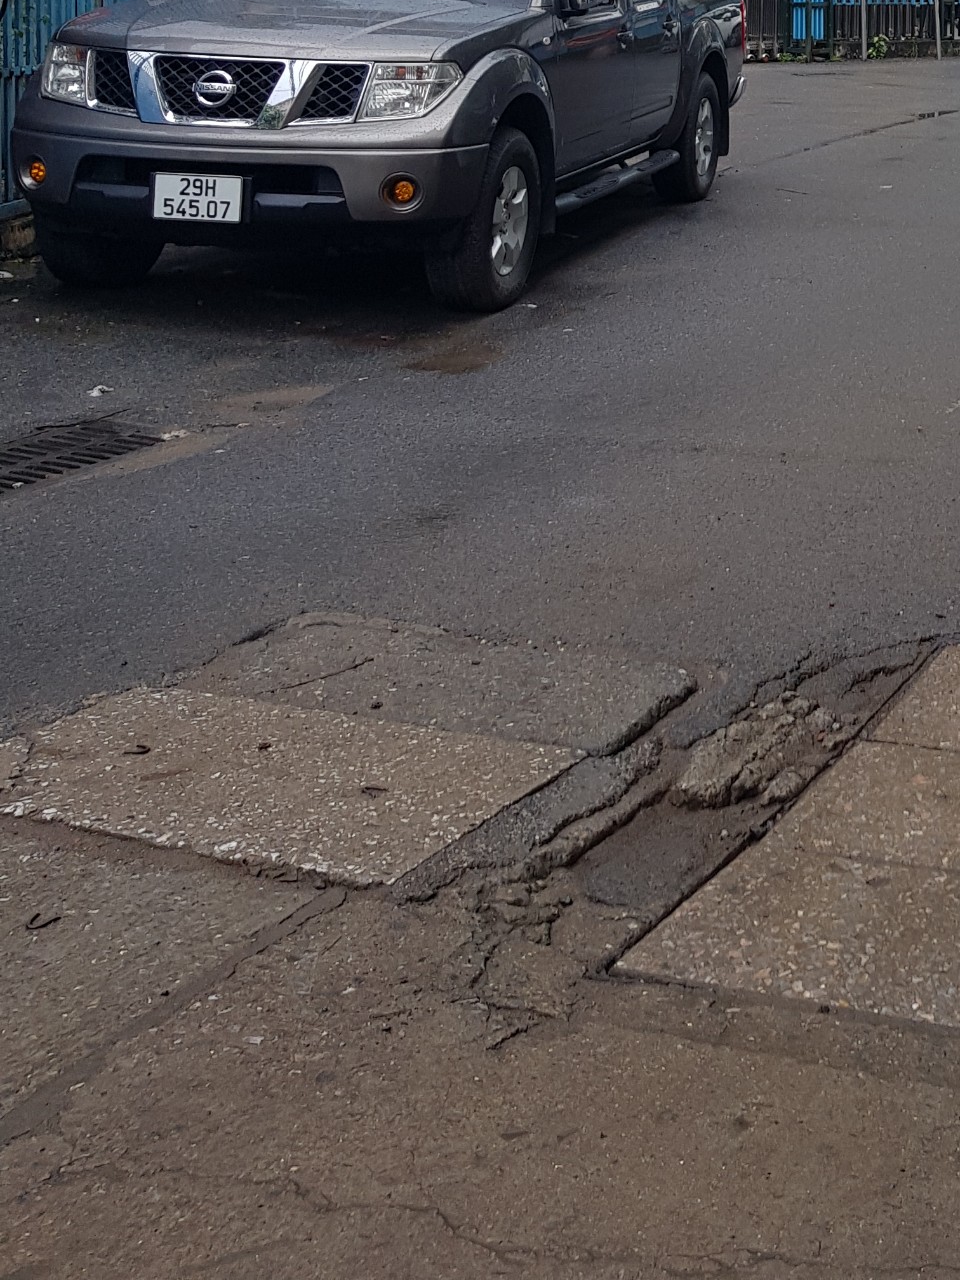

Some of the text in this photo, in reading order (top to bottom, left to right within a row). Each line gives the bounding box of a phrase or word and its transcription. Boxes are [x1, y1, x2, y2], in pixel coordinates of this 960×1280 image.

[196, 83, 232, 93] NISSAN
[179, 177, 217, 197] 29H
[163, 197, 231, 219] 545.07
